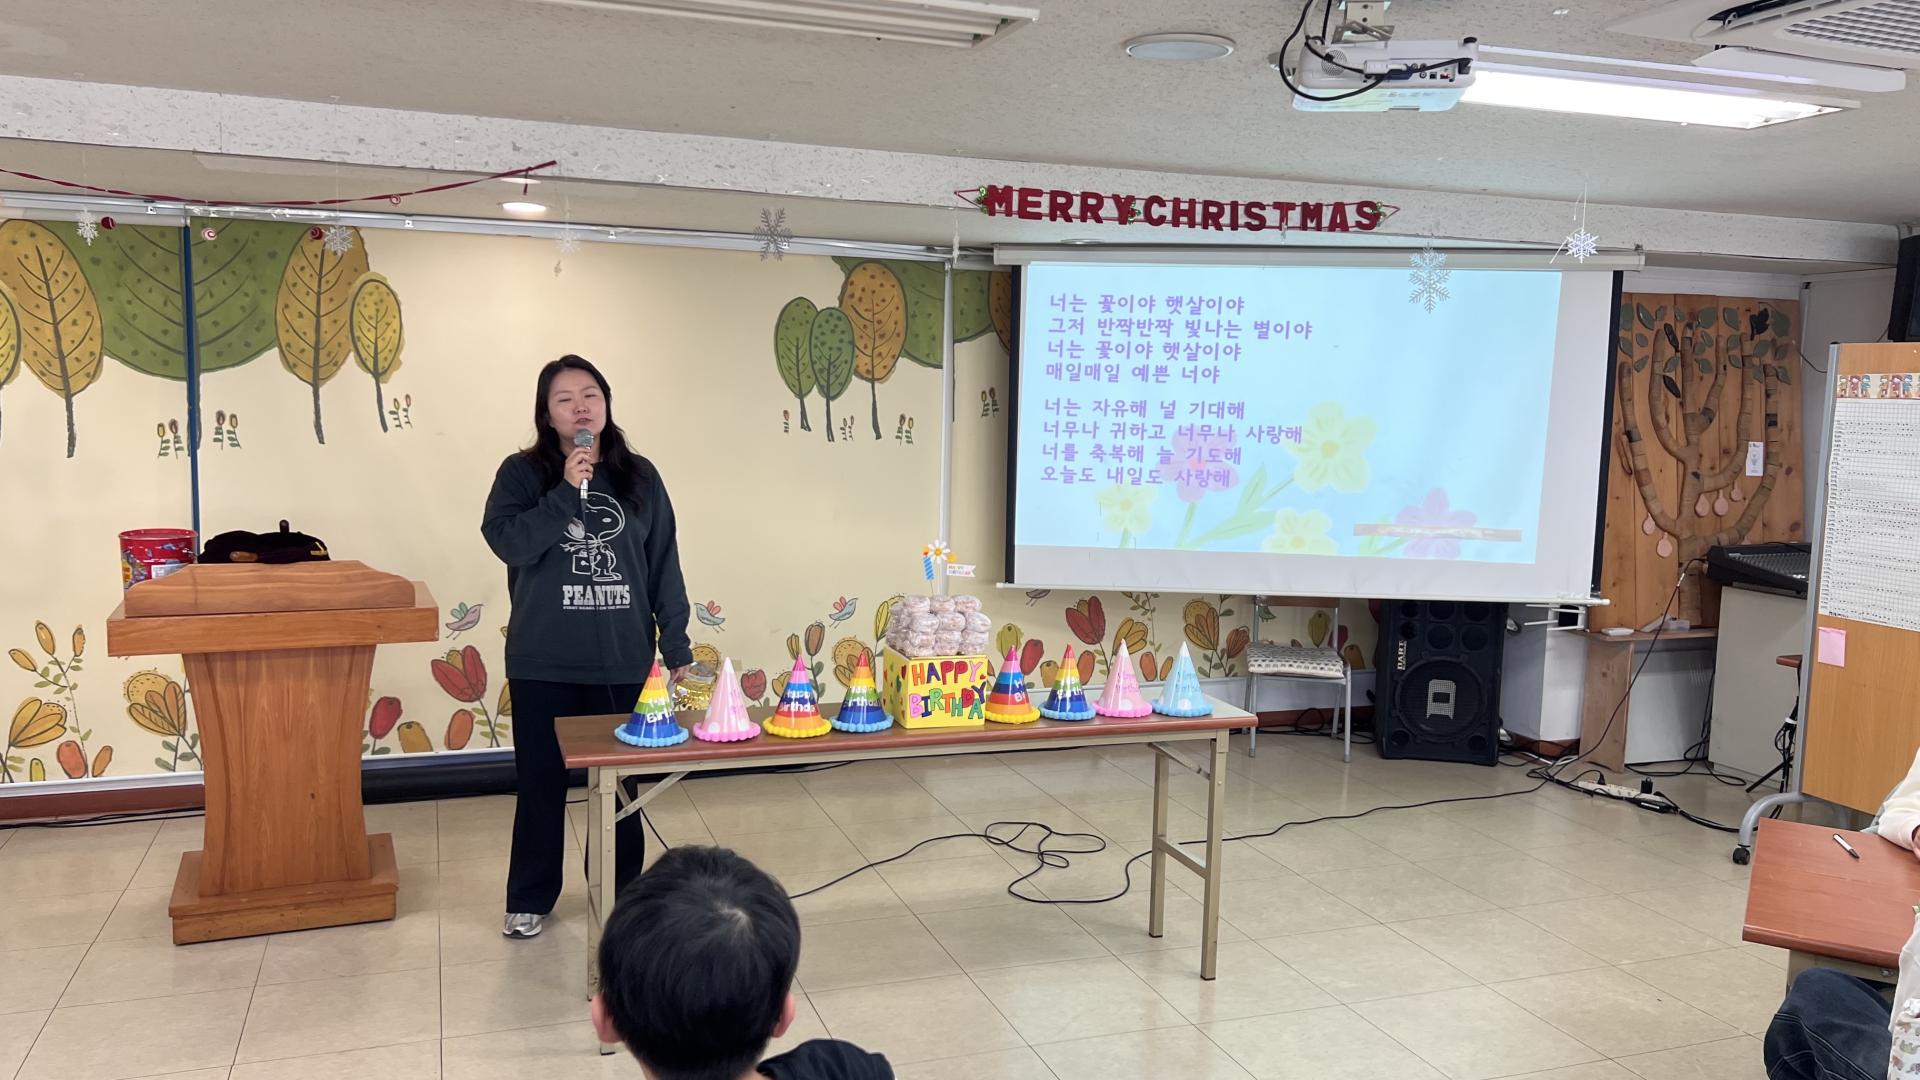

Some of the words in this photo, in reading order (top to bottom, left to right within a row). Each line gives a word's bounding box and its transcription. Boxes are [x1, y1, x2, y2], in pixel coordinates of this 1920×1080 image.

[986, 185, 1135, 225] MERRY
[1143, 196, 1379, 232] CHRISTMAS
[1050, 294, 1087, 312] 너는
[1098, 294, 1156, 313] 꽃이야
[1166, 296, 1244, 315] 햇살이야
[1048, 318, 1084, 334] 그저
[1098, 318, 1174, 338] 반짝반짝
[1185, 320, 1242, 338] 빛나는
[1254, 320, 1312, 340] 별이야
[1048, 340, 1084, 359] 너는
[1096, 341, 1153, 360] 꽃이야
[1162, 342, 1242, 361] 햇살이야
[1046, 363, 1120, 382] 매일매일
[1132, 364, 1170, 383] 예쁜
[1182, 366, 1220, 384] 너야
[1044, 398, 1080, 416] 너는
[1092, 399, 1147, 418] 자유해
[1160, 400, 1176, 419] 널
[1189, 402, 1245, 420] 기대해
[1043, 420, 1099, 439] 너무나
[1110, 422, 1166, 440] 귀하고
[1178, 424, 1235, 442] 너무나
[1246, 426, 1302, 444] 사랑해
[1042, 443, 1078, 462] 너를
[1090, 444, 1144, 463] 축복해
[1156, 446, 1174, 464] 늘
[1187, 446, 1241, 466] 기도해
[1040, 465, 1096, 484] 오늘도
[1107, 466, 1163, 485] 내일도
[1174, 469, 1230, 488] 사랑해
[562, 584, 631, 606] PEANUTS
[1397, 640, 1405, 671] DART
[911, 660, 983, 686] HAPPY
[909, 681, 986, 719] BIRTHDAY
